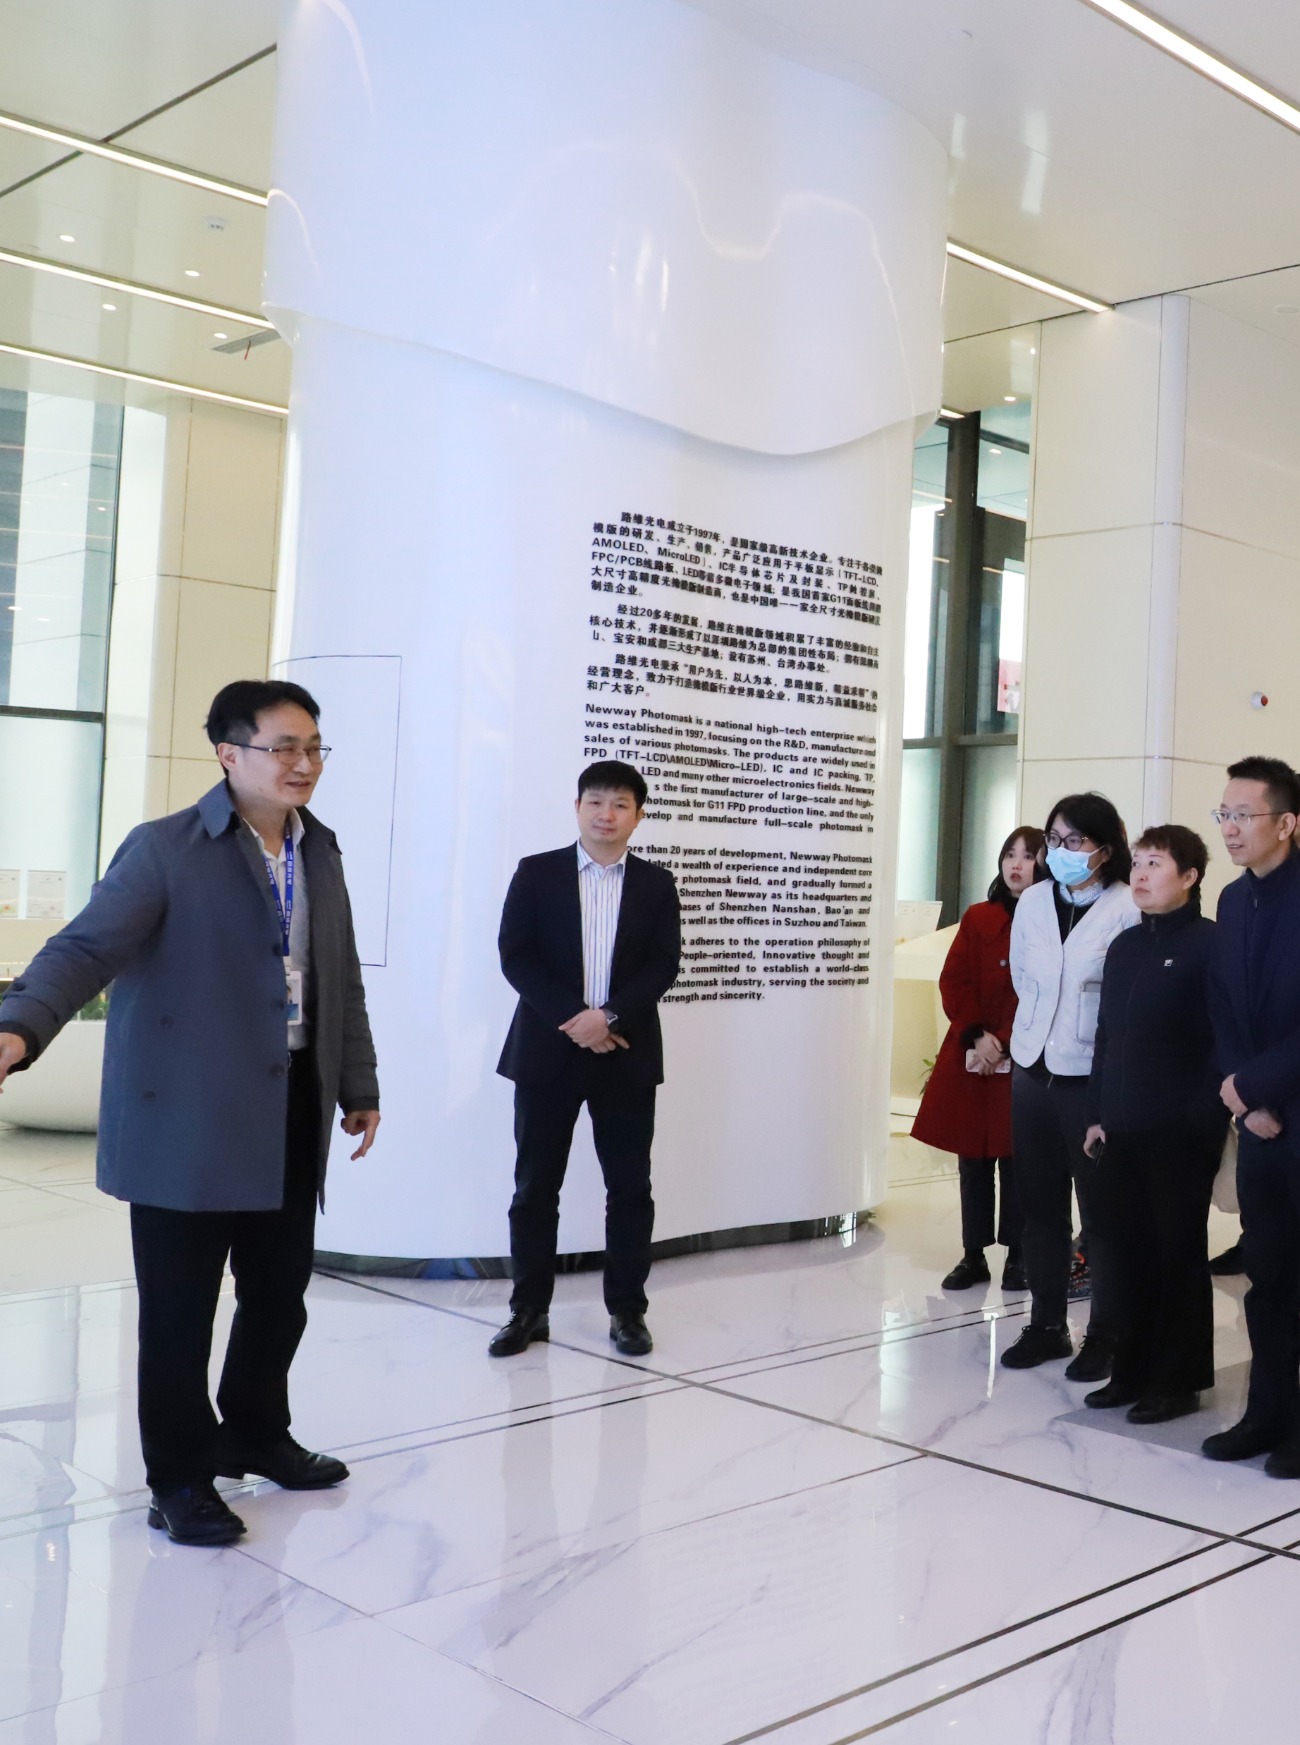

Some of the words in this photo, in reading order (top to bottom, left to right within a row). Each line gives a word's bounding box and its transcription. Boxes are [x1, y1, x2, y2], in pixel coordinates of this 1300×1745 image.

[586, 704, 636, 718] Newway
[641, 708, 692, 723] Photomask
[714, 720, 752, 732] national
[810, 729, 854, 741] enterprise
[585, 720, 608, 729] was
[612, 722, 673, 735] established
[686, 728, 706, 740] 1997,
[708, 732, 748, 746] focusing
[750, 736, 762, 745] on
[765, 737, 781, 747] the
[811, 742, 864, 755] manufacture
[584, 734, 614, 744] sales
[620, 736, 630, 745] of
[635, 738, 672, 749] various
[674, 742, 730, 756] photomasks.
[733, 748, 750, 758] The
[754, 750, 798, 762] products
[802, 755, 818, 763] are
[821, 756, 849, 768] widely
[852, 760, 868, 769] used
[584, 748, 607, 758] FPD
[773, 764, 783, 773] IC
[790, 766, 808, 776] and
[814, 768, 824, 777] IC
[663, 768, 680, 778] and
[682, 772, 706, 782] many
[706, 774, 730, 783] other
[732, 776, 814, 790] microelectronics
[664, 783, 678, 792] the
[681, 784, 698, 794] first
[701, 787, 764, 799] manufacturer
[768, 791, 778, 800] of
[839, 798, 854, 806] and
[646, 796, 691, 808] hotomask
[693, 798, 705, 808] for
[708, 800, 724, 810] G11
[728, 802, 746, 812] FPD
[748, 804, 804, 815] production
[830, 810, 844, 818] and
[846, 810, 858, 819] the
[860, 812, 874, 822] only
[699, 814, 757, 825] manufacture
[820, 822, 863, 832] photomask
[647, 845, 668, 854] than
[670, 846, 680, 854] 20
[684, 848, 706, 856] years
[708, 848, 717, 856] of
[720, 849, 786, 860] development,
[790, 852, 831, 862] Newway
[682, 860, 711, 870] wealth
[714, 861, 723, 870] of
[726, 862, 779, 872] experience
[782, 865, 802, 873] and
[804, 866, 858, 876] independent
[682, 875, 732, 884] photomask
[768, 878, 786, 886] and
[792, 880, 836, 889] gradually
[680, 888, 722, 898] Shenzhen
[726, 889, 767, 900] Newway
[786, 890, 798, 900] its
[802, 892, 858, 902] headquarters
[860, 894, 872, 902] and
[706, 902, 715, 911] of
[720, 902, 767, 912] Shenzhen
[688, 916, 706, 925] well
[720, 916, 734, 925] the
[737, 916, 770, 926] offices
[772, 917, 782, 926] in
[784, 918, 820, 927] Suzhou
[822, 919, 838, 928] and
[690, 937, 724, 946] adheres
[729, 937, 739, 946] to
[744, 937, 760, 946] the
[765, 938, 814, 947] operation
[818, 938, 861, 948] philosophy
[762, 950, 816, 960] Innovative
[822, 952, 854, 960] thought
[690, 964, 740, 973] committed
[746, 964, 756, 973] to
[764, 964, 809, 973] establish
[770, 978, 806, 988] serving
[810, 978, 825, 986] the
[828, 978, 856, 986] society
[662, 992, 700, 1004] strength
[702, 992, 718, 1000] and
[720, 992, 765, 1001] sincerity.
